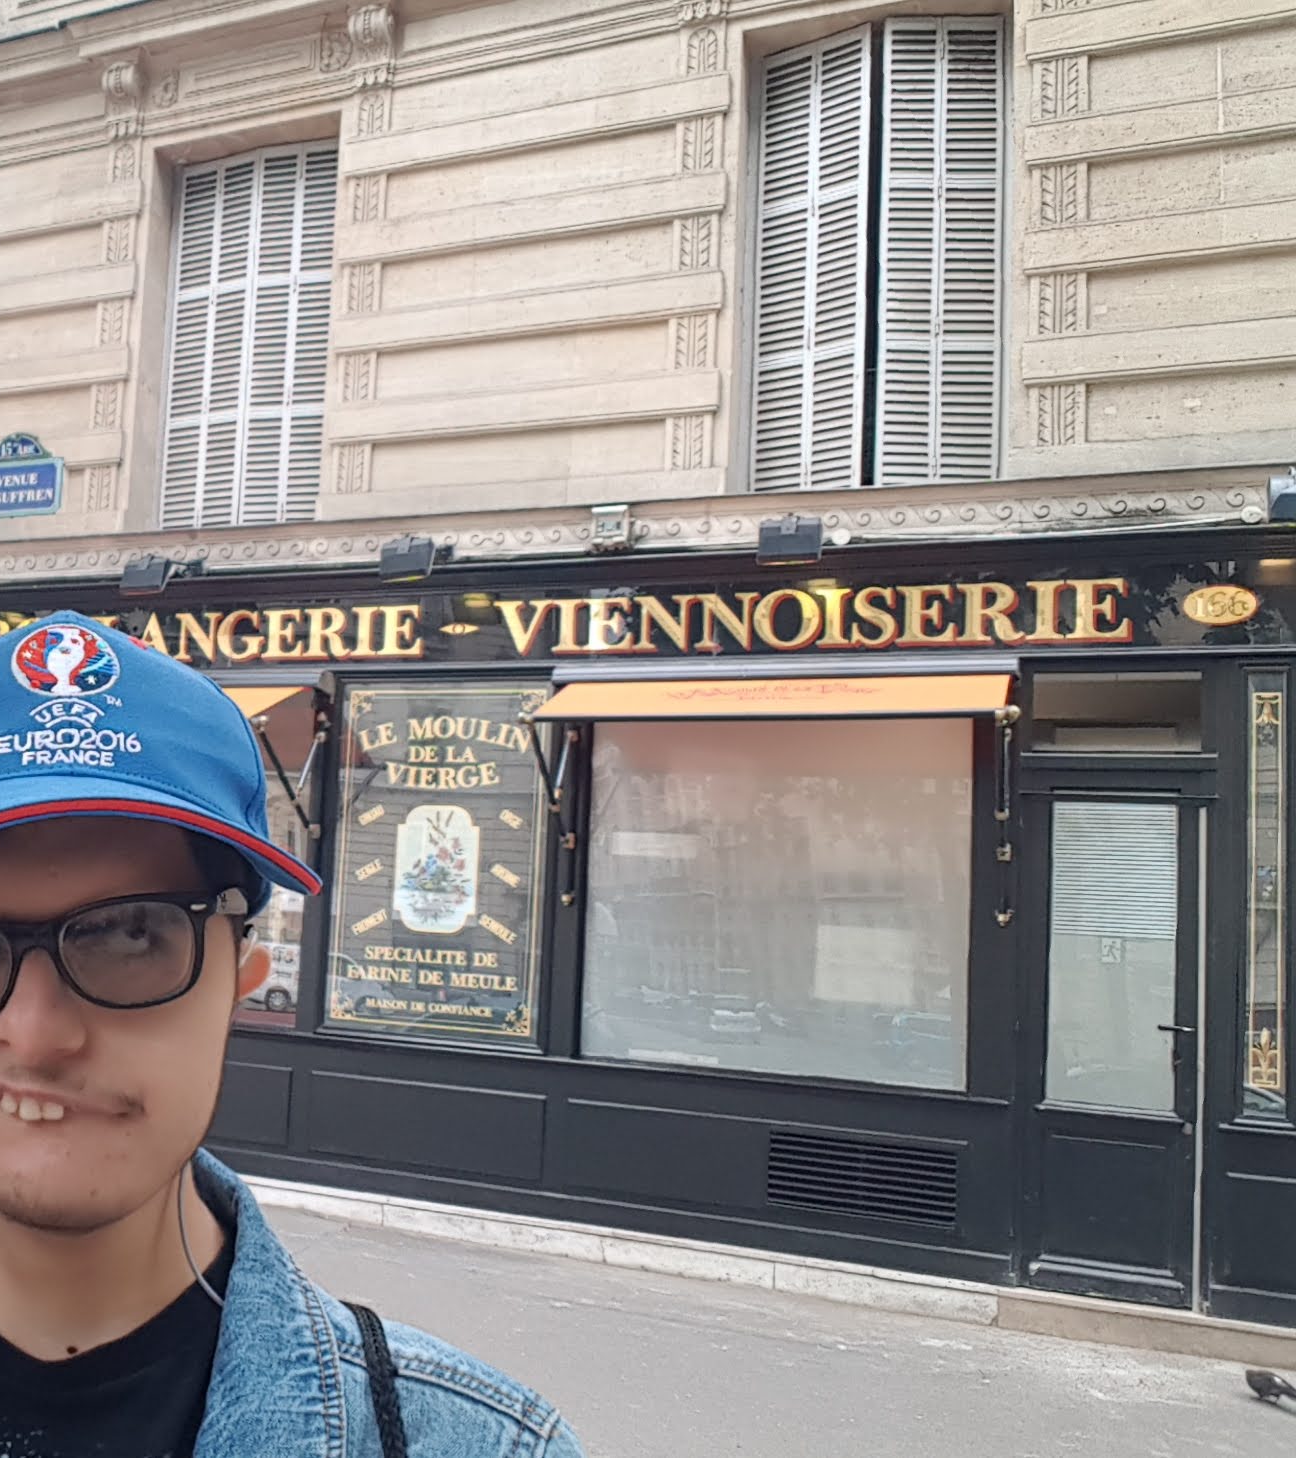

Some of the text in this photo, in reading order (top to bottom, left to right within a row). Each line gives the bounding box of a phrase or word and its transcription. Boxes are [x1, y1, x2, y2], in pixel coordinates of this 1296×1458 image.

[1189, 590, 1249, 618] 166
[495, 578, 1133, 656] VIENNOISERIE
[34, 703, 99, 723] UEFA
[358, 715, 531, 754] LE MOULIN
[21, 750, 115, 767] FRANCE
[408, 746, 478, 763] DE LA
[384, 761, 500, 790] VIERGE
[364, 945, 498, 968] SPECIALITE DE
[347, 965, 518, 991] FARINE DE MEULE
[365, 998, 493, 1018] MAISON DE CONFIANCE
